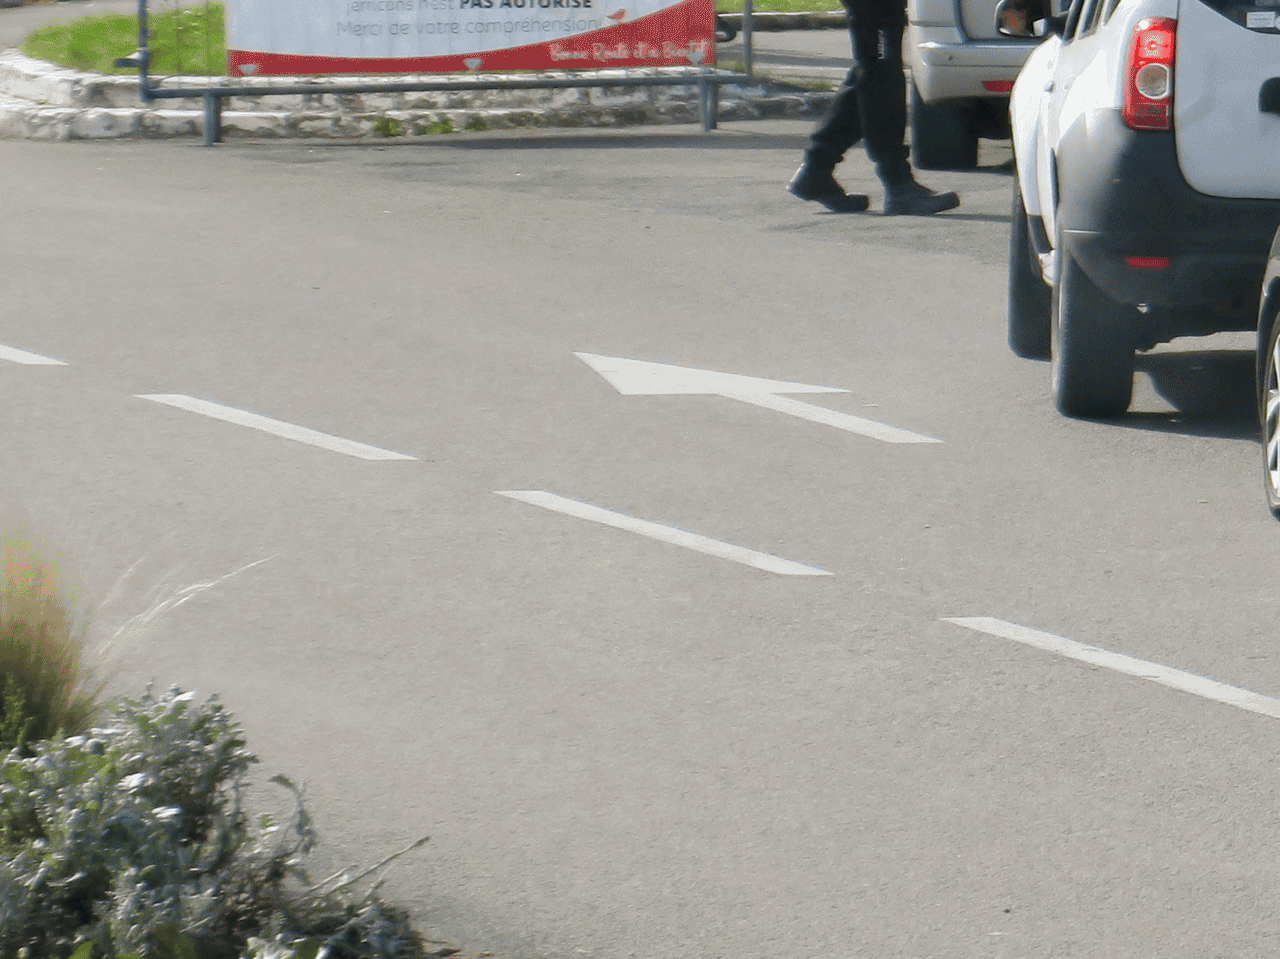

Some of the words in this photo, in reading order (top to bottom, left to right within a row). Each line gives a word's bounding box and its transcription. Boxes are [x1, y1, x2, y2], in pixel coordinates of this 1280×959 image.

[336, 19, 383, 37] Merci
[388, 20, 411, 36] de
[416, 20, 460, 35] votre
